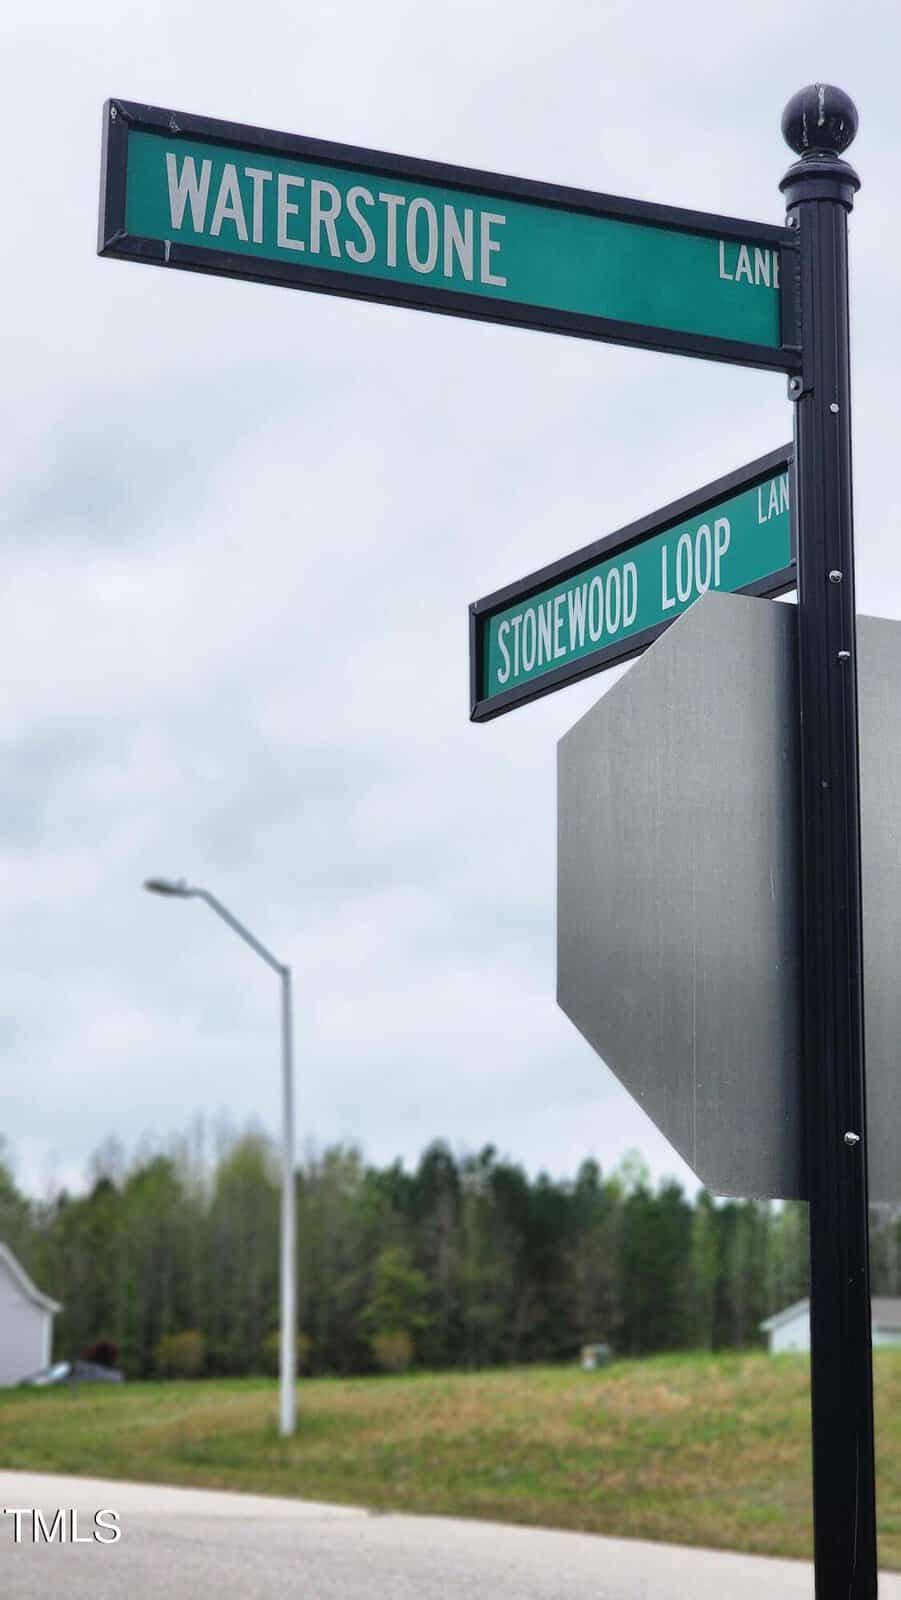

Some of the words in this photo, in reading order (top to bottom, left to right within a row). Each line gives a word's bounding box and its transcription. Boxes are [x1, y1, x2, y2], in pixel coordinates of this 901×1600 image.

[165, 151, 508, 287] WATERSTONE
[496, 560, 639, 684] STONEWOOD
[660, 517, 732, 611] LOOP
